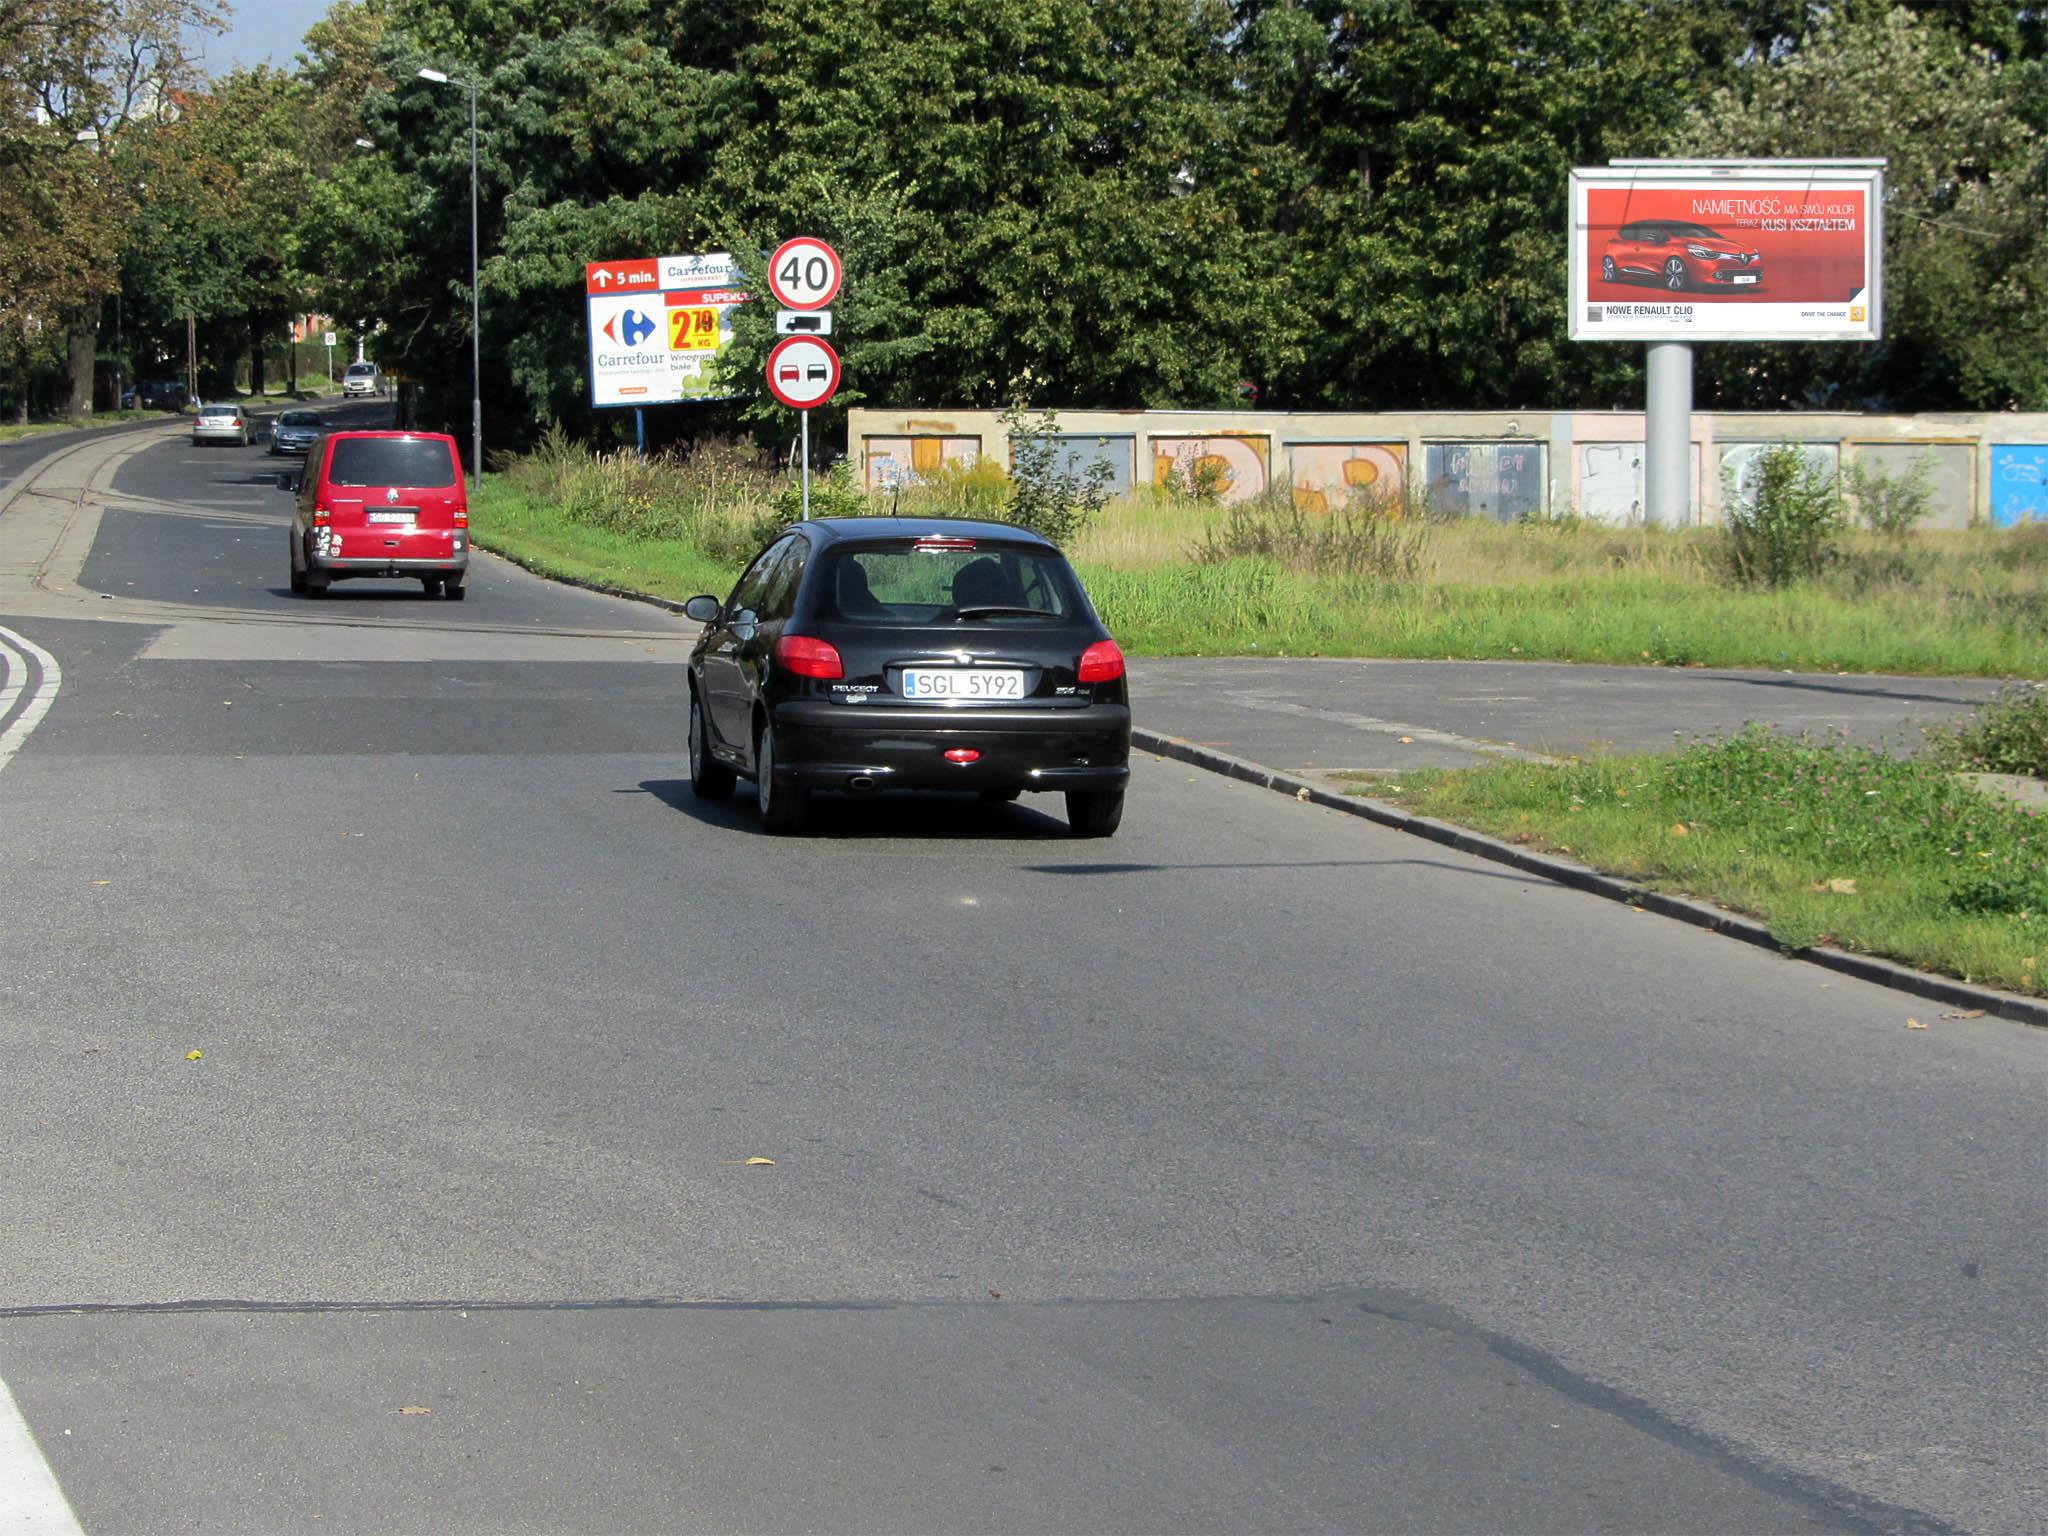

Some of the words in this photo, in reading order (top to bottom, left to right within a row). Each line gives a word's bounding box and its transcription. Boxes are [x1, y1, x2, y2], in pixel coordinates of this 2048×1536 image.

[1692, 196, 1780, 217] NAMIĘTNOŚĆ
[1784, 205, 1799, 214] MA
[1801, 202, 1825, 215] SWÓJ
[1827, 204, 1855, 215] KOLOR
[1735, 218, 1758, 228] TERAZ
[1761, 218, 1787, 231] KUSI
[1790, 218, 1855, 231] KSZTAŁTEM
[667, 264, 731, 277] Carrefour
[779, 256, 829, 291] 40
[617, 272, 625, 285] 5
[629, 271, 656, 284] min.
[1606, 306, 1631, 315] NOWE
[1634, 306, 1671, 315] RENAULT
[1673, 306, 1693, 315] CLIO
[672, 311, 691, 349] 2
[697, 338, 711, 347] KG
[598, 352, 665, 367] Carrefour
[670, 353, 716, 362] Winogrona
[670, 362, 691, 371] białe
[832, 685, 879, 693] PEUGEOT
[917, 674, 962, 696] SGL
[970, 674, 1018, 696] 5Y92
